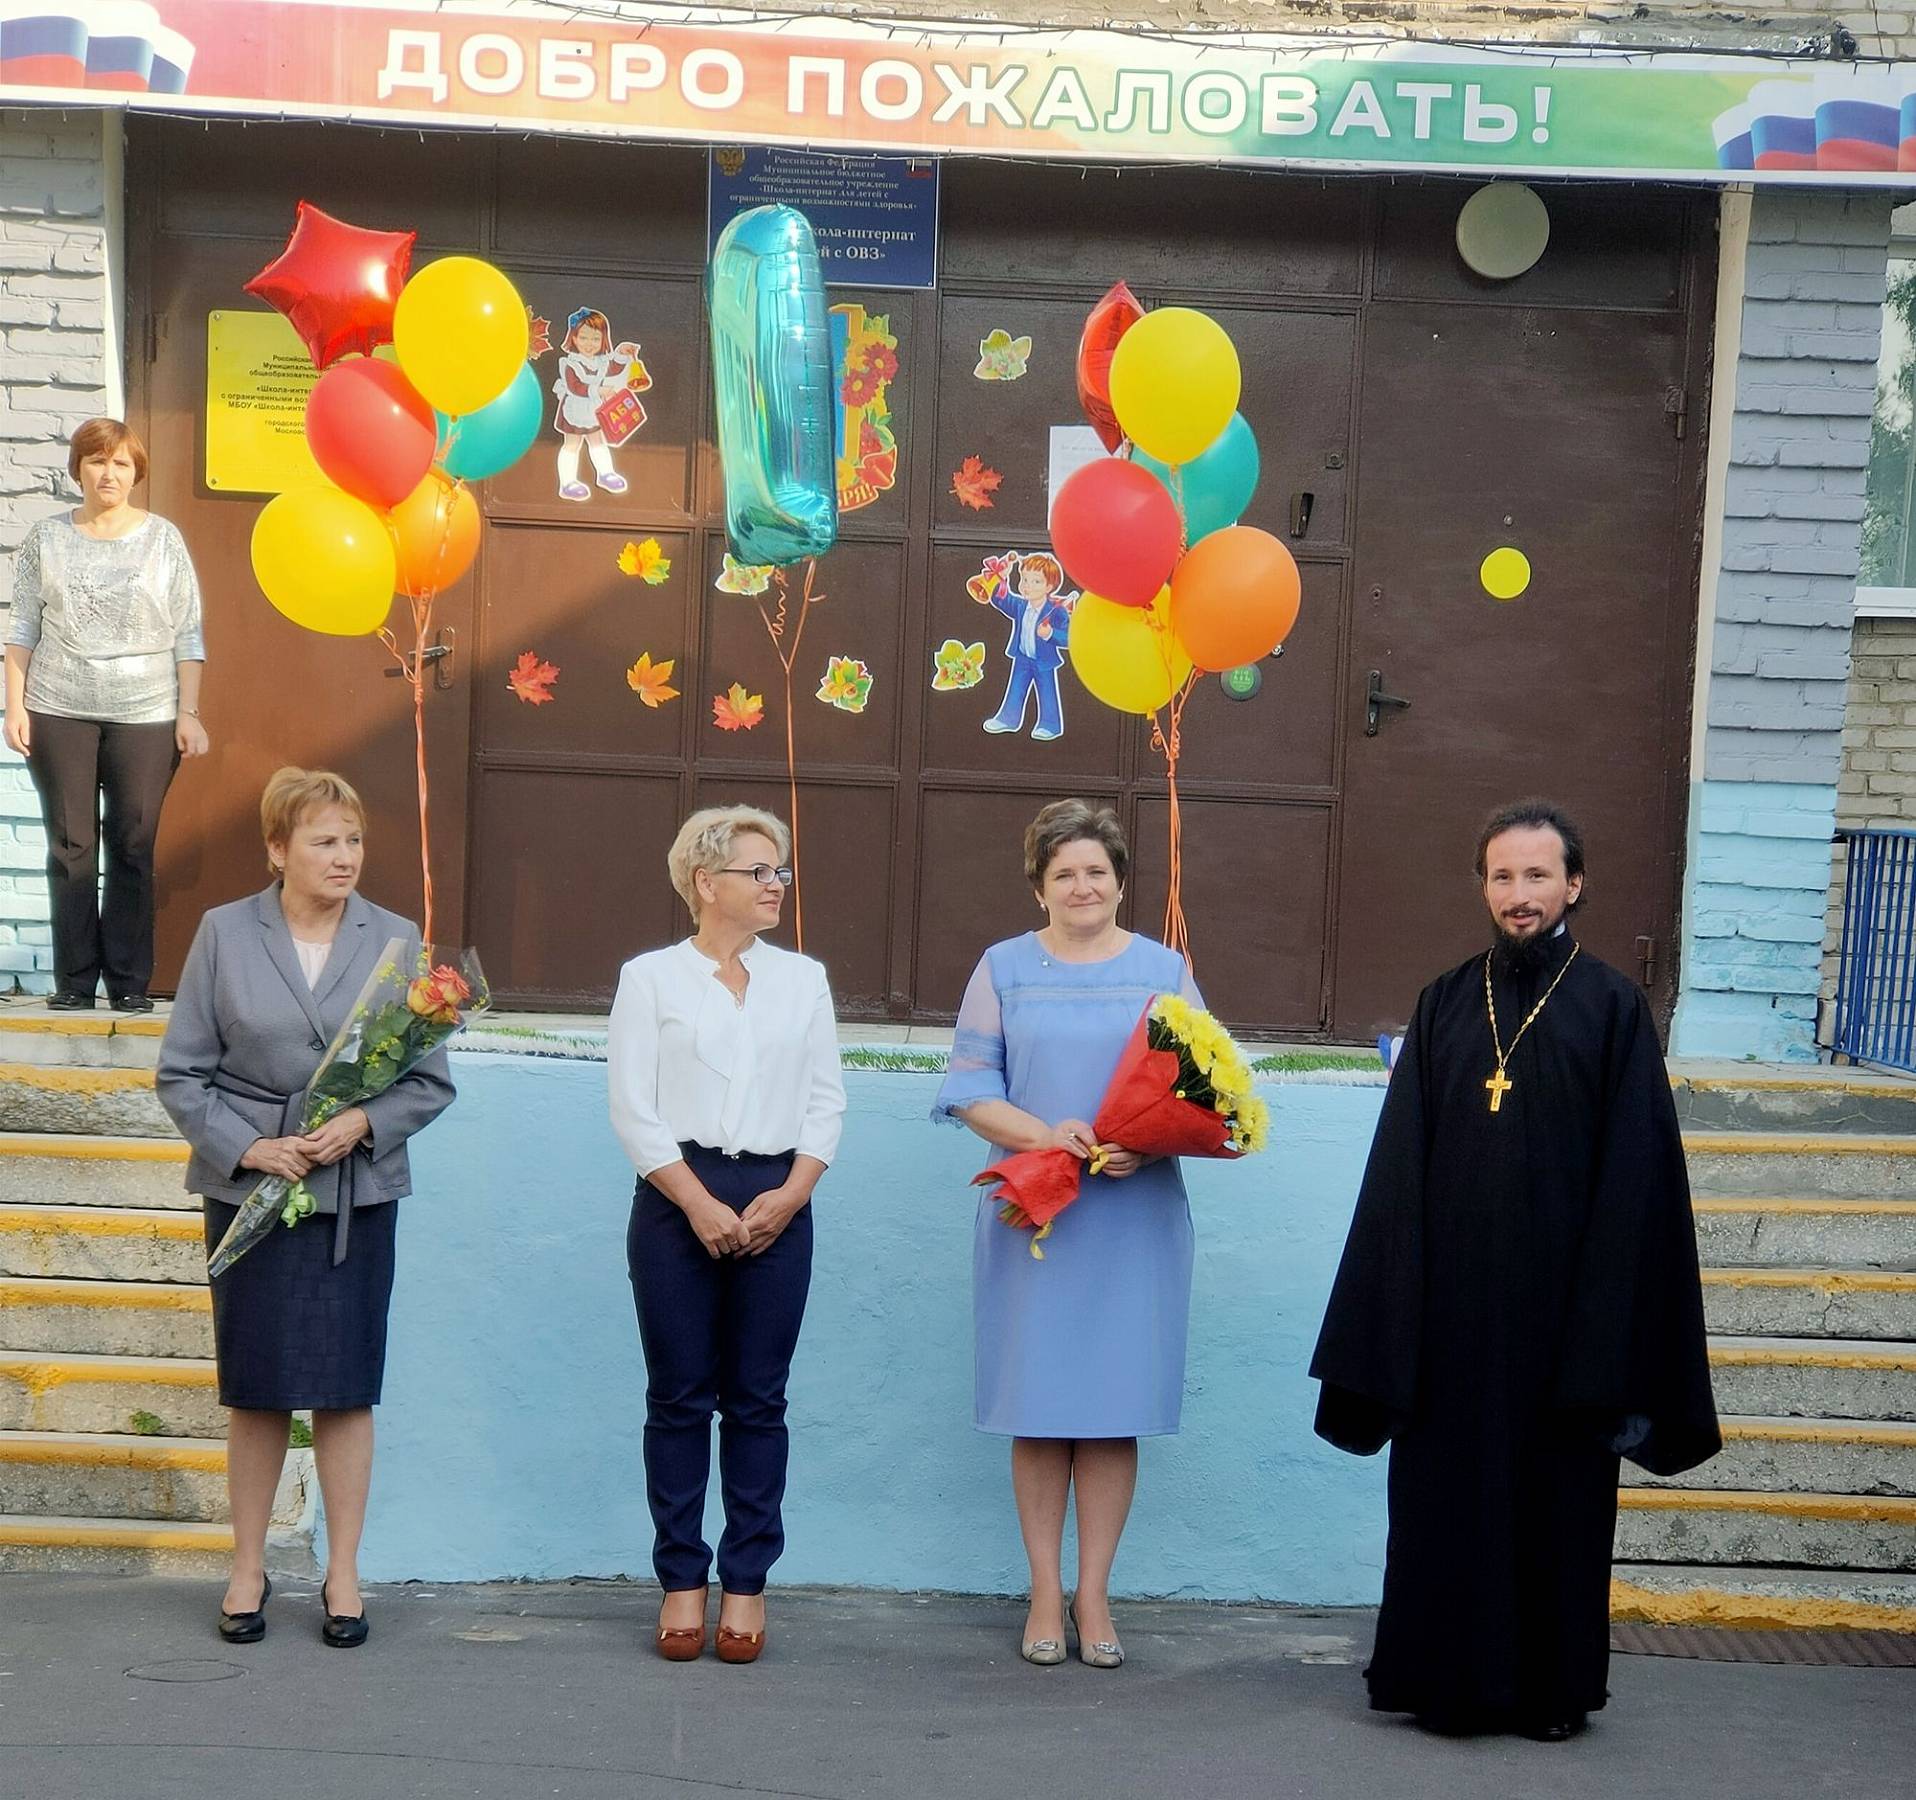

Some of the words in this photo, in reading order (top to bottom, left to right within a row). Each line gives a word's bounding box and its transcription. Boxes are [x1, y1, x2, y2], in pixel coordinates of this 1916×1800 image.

[378, 28, 744, 109] ДОБРО
[787, 55, 1551, 144] ПОЖАЛОВАТЬ!
[228, 401, 252, 409] МБОУ
